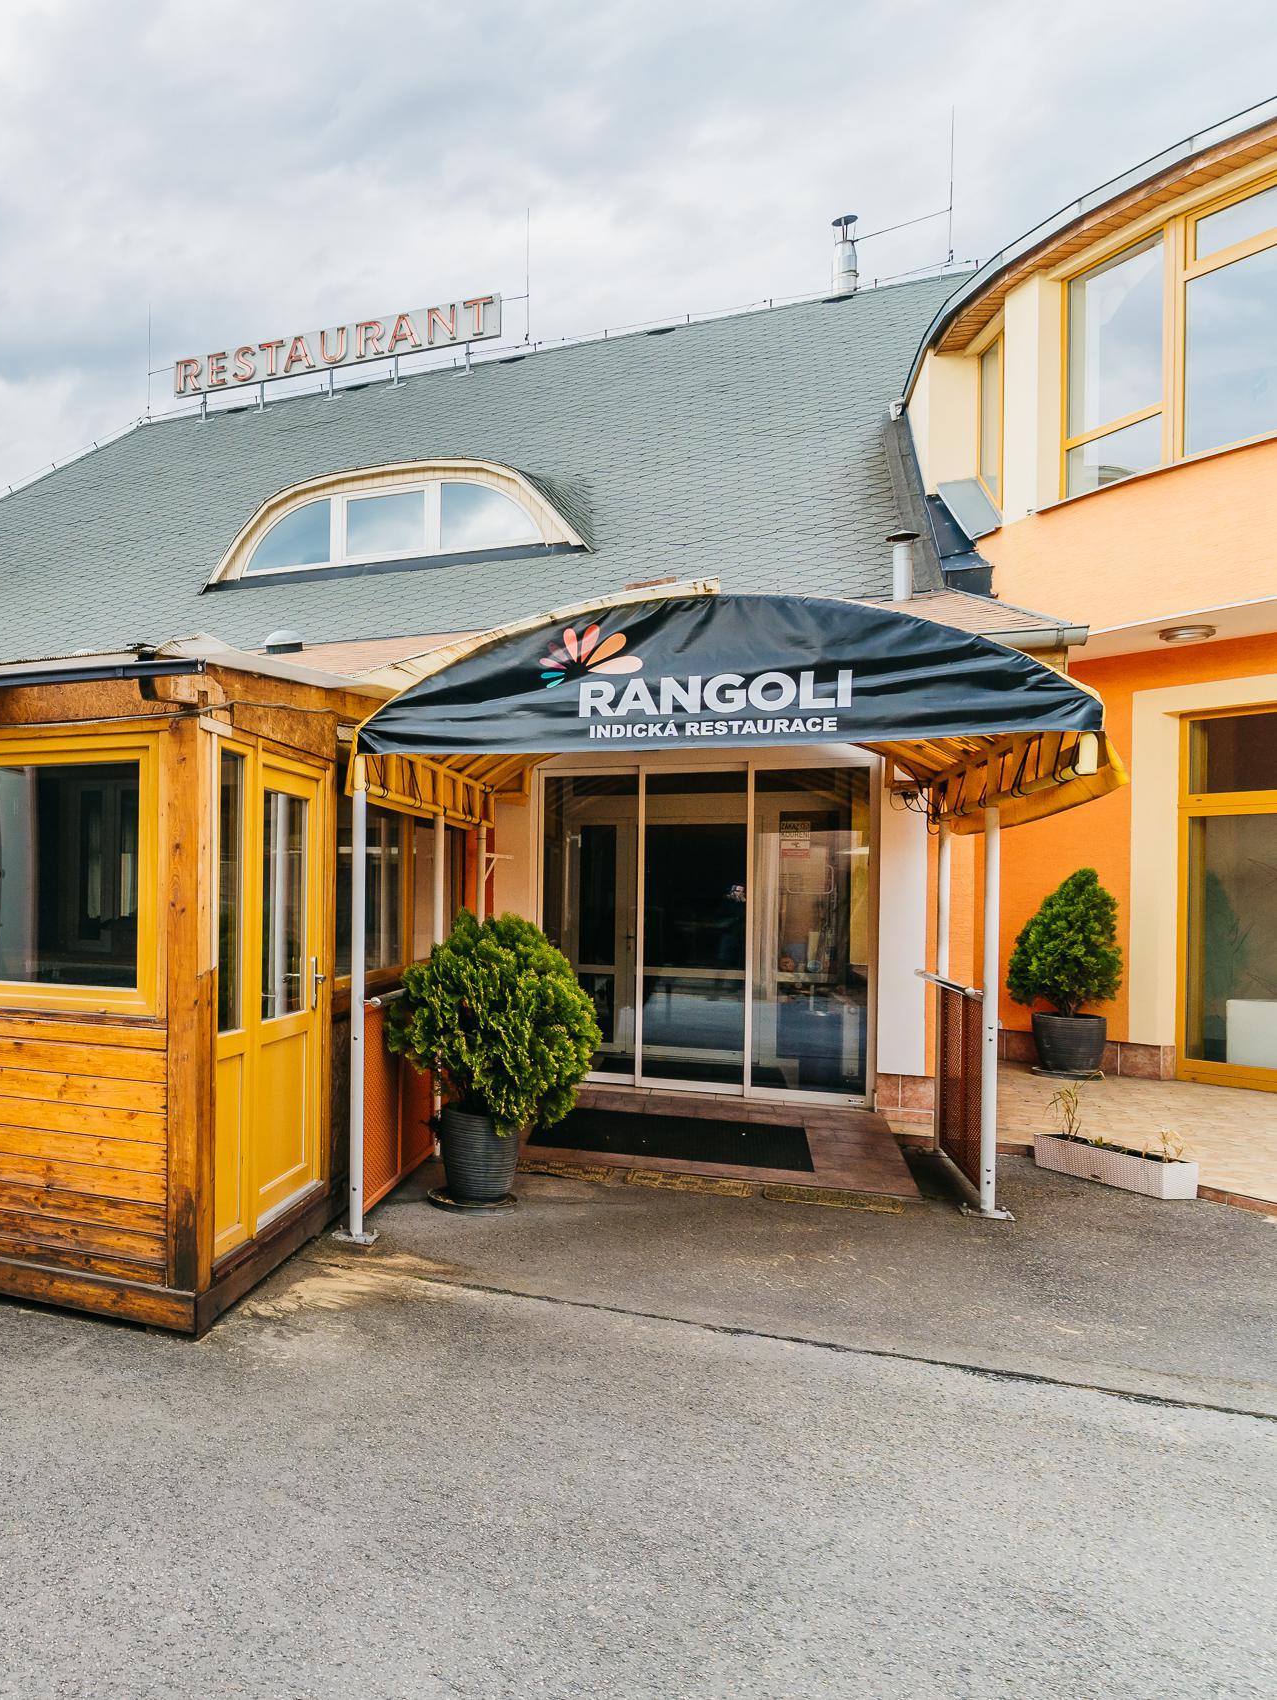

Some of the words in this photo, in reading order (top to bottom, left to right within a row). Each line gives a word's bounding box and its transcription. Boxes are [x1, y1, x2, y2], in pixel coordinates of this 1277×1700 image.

[175, 296, 494, 394] RESTAURANT
[578, 669, 853, 718] RANGOLI
[589, 719, 678, 739] INDICKÁ
[685, 717, 838, 737] RESTAURACE
